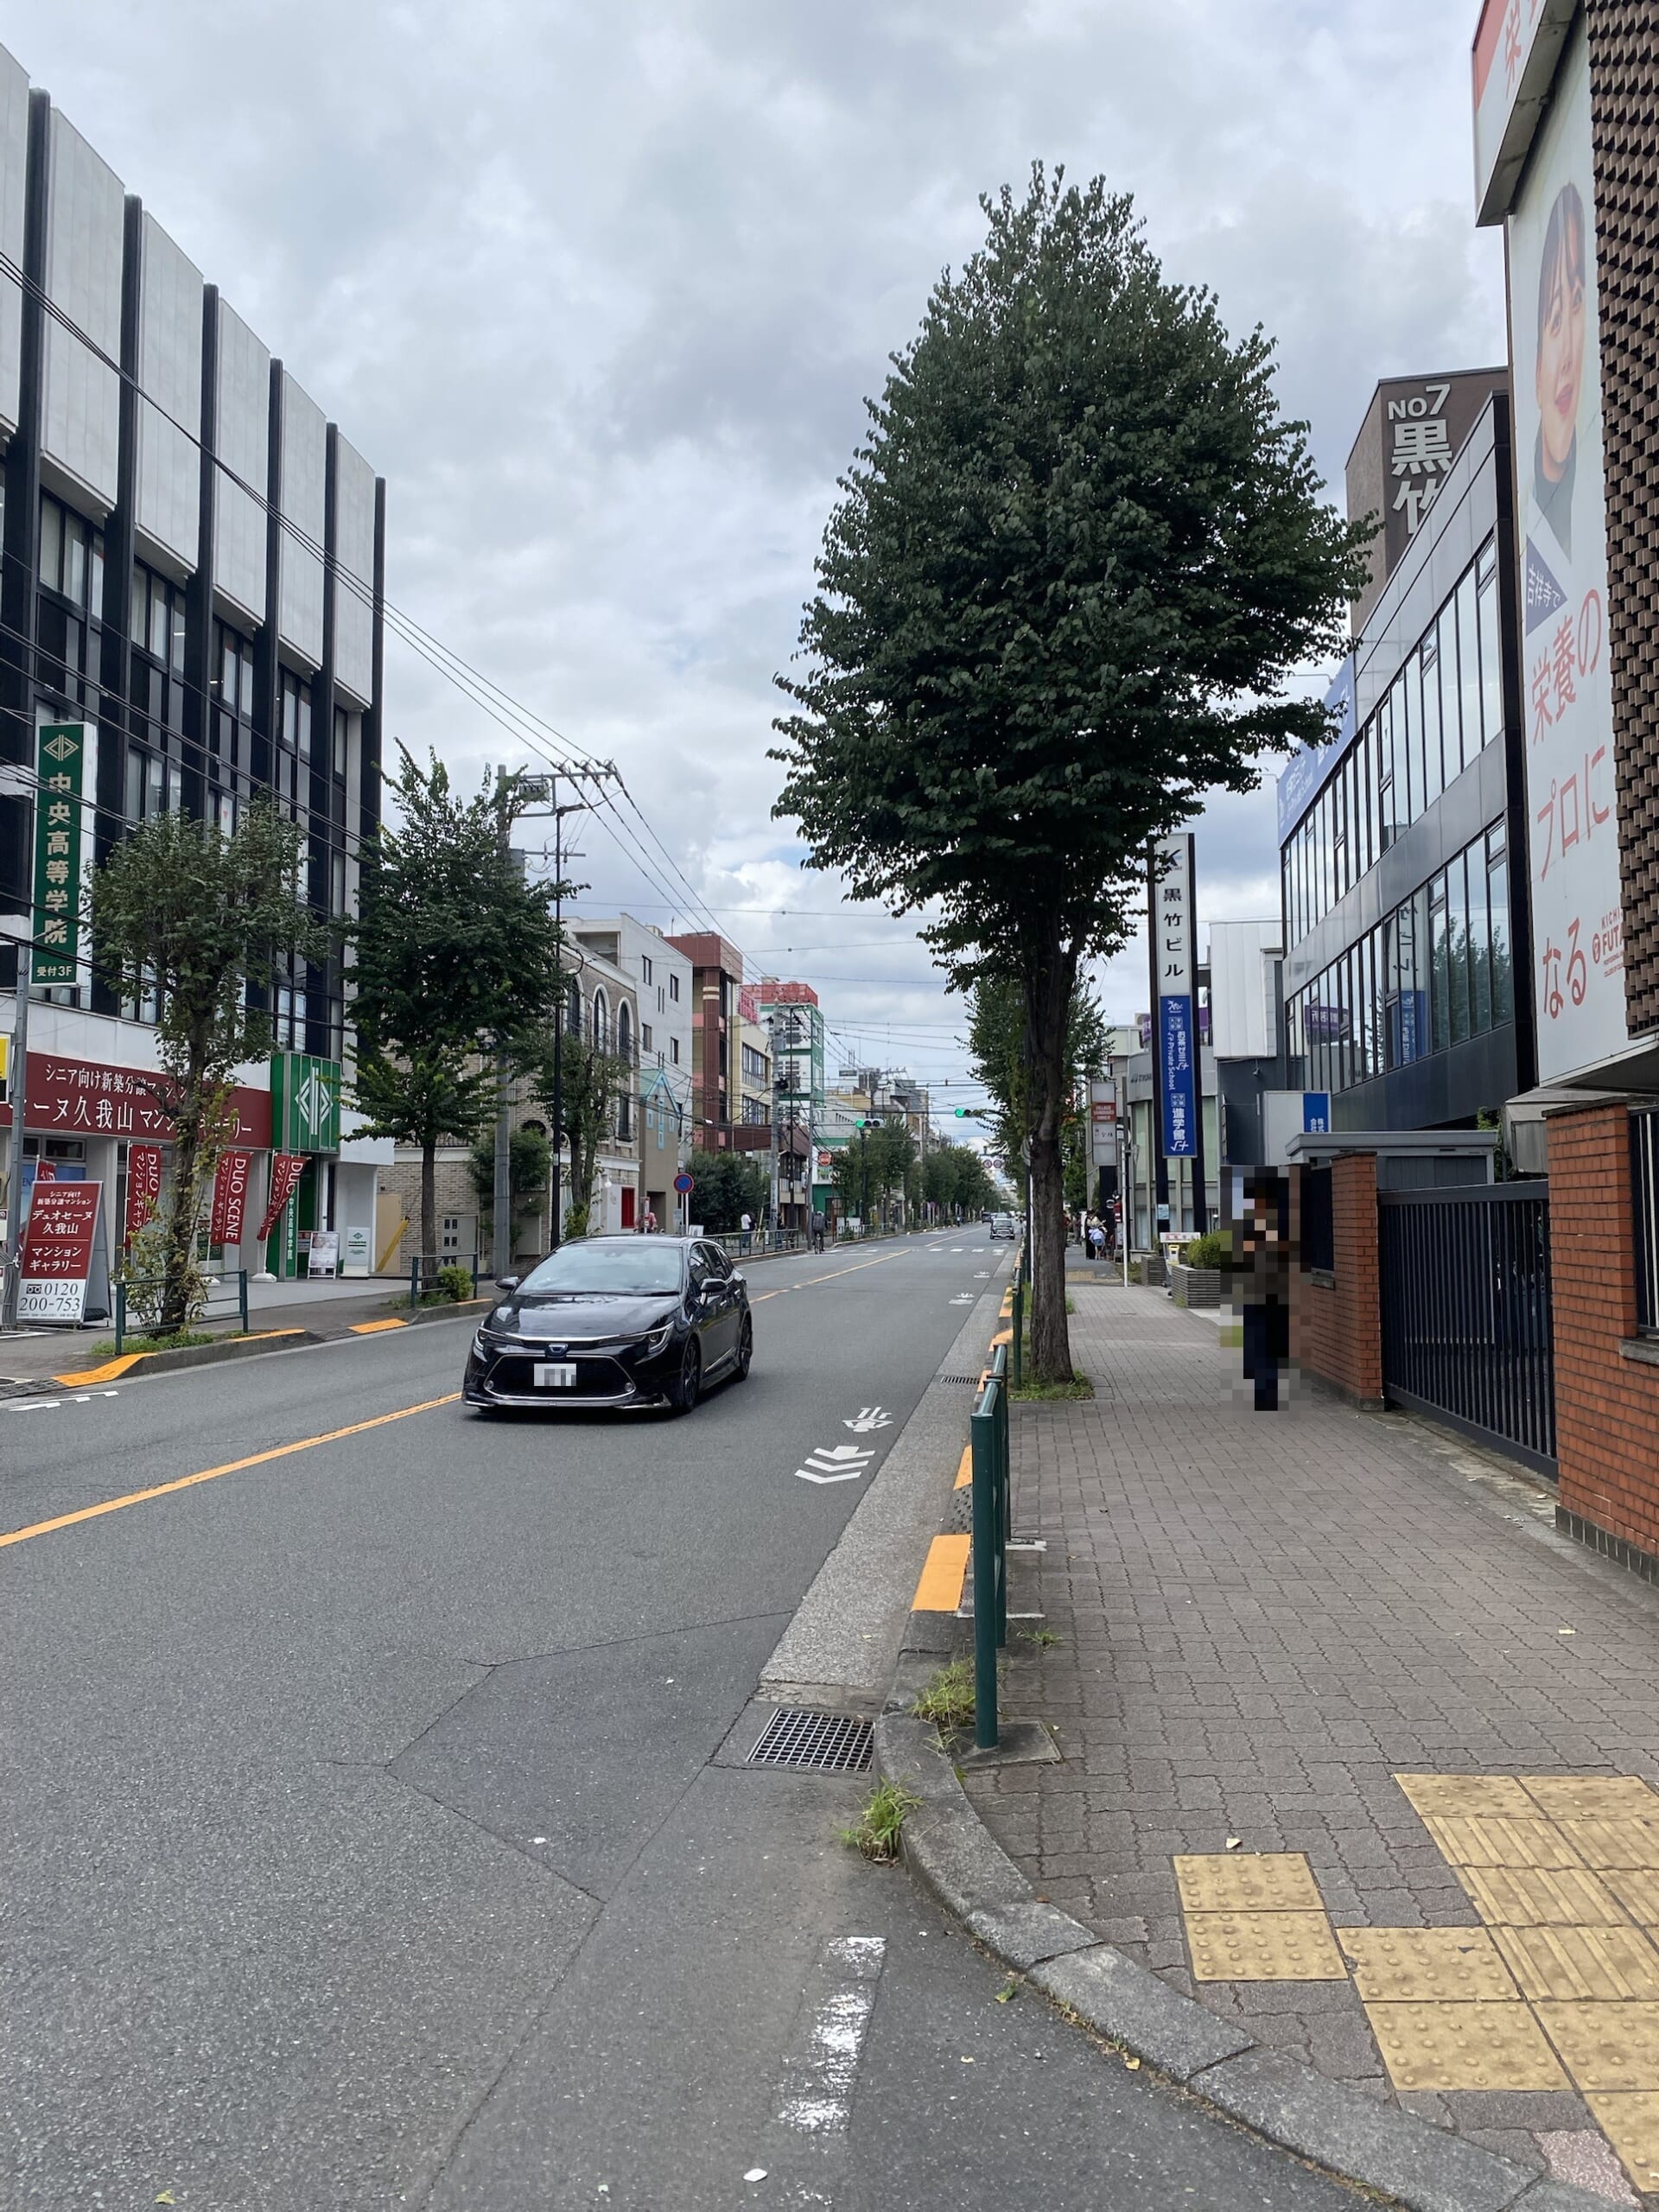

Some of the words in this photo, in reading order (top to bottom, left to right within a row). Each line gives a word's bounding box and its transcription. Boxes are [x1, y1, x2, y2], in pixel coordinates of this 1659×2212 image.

[1531, 588, 1602, 747] 栄養の
[1537, 744, 1610, 881] プロに
[44, 772, 71, 944] 中央高等学院
[1163, 887, 1185, 978] 黒竹ビル
[36, 965, 73, 977] 受付3F
[1542, 916, 1586, 1020] なる
[147, 1153, 159, 1192] DUO
[230, 1158, 247, 1194] DUO
[31, 1210, 93, 1221] デュオセーヌ
[41, 1222, 79, 1235] 久我山
[226, 1197, 242, 1240] SCENE
[29, 1261, 81, 1273] ギャラリー
[31, 1246, 83, 1256] マンション
[19, 1297, 80, 1312] 200-753
[44, 1282, 79, 1296] 0120
